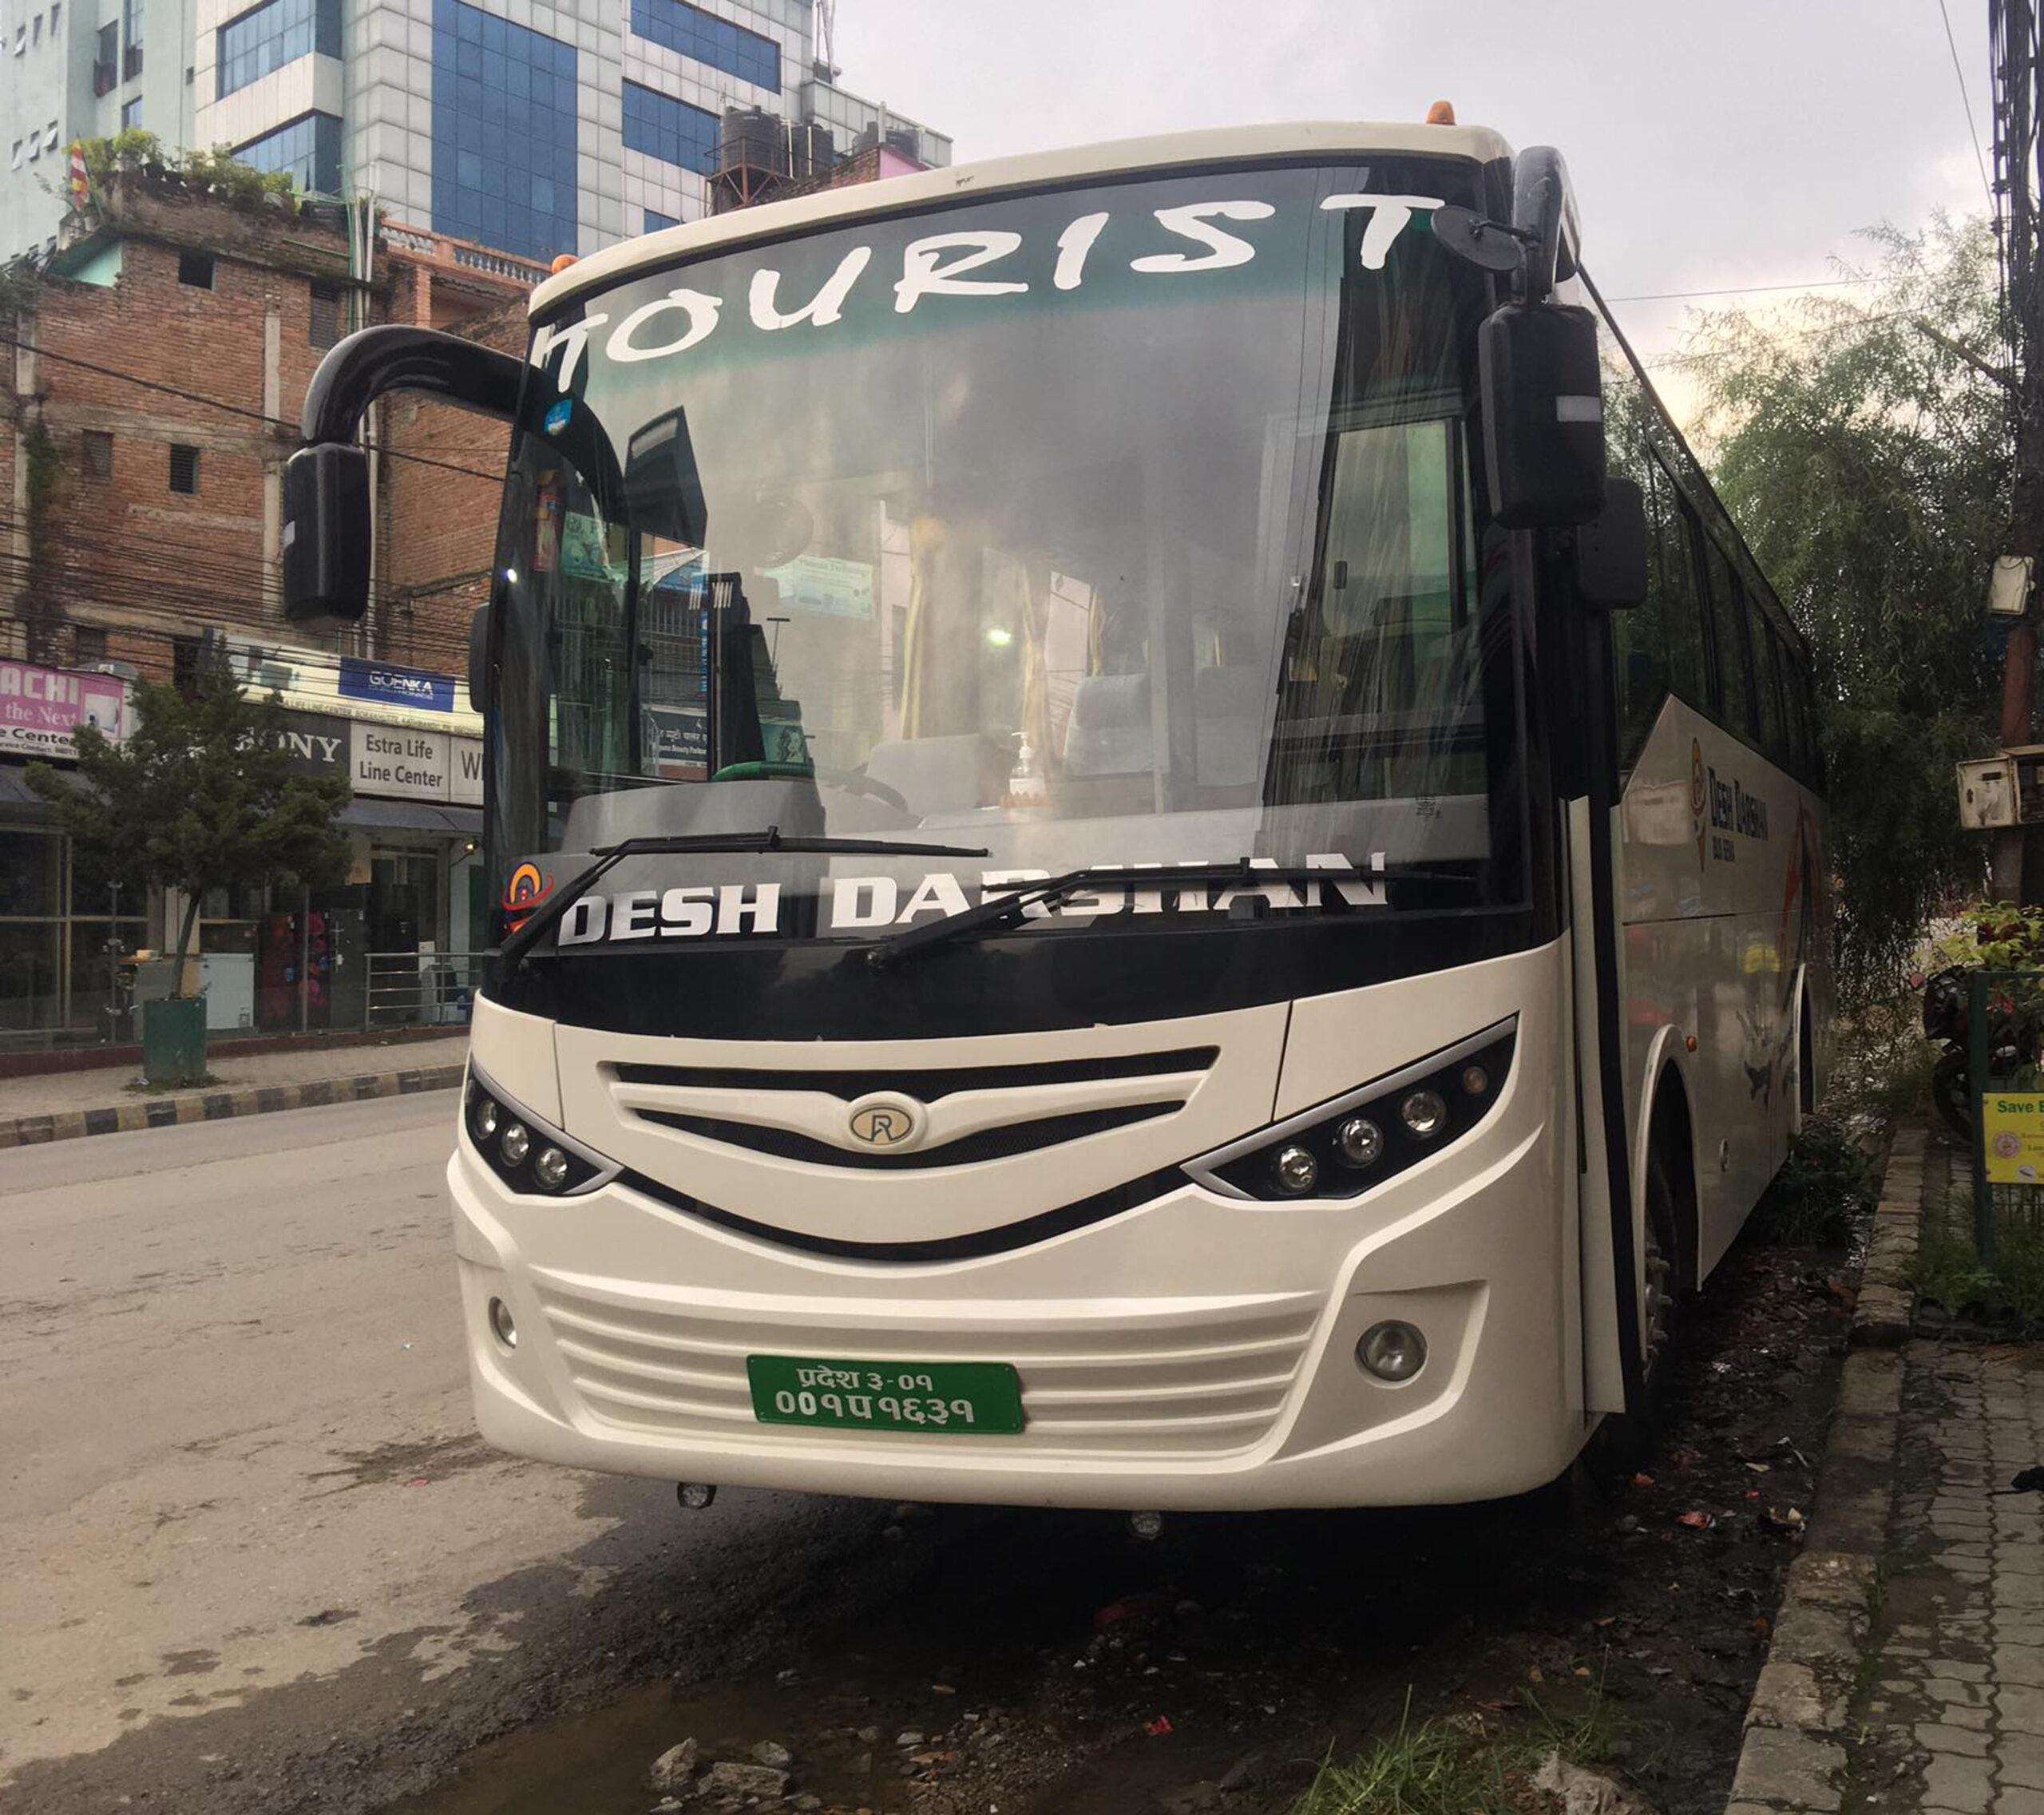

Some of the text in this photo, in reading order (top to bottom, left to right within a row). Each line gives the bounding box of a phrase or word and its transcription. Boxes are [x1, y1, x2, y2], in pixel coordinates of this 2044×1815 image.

[529, 194, 1445, 392] TOURIST
[370, 671, 433, 692] GOENKA
[6, 700, 77, 727] the Next
[12, 727, 74, 746] Cente
[366, 734, 434, 759] Estra Life
[360, 760, 443, 787] Line Center
[558, 882, 782, 947] DESH
[1997, 1100, 2034, 1113] Save
[796, 1365, 861, 1389] प्रदेश
